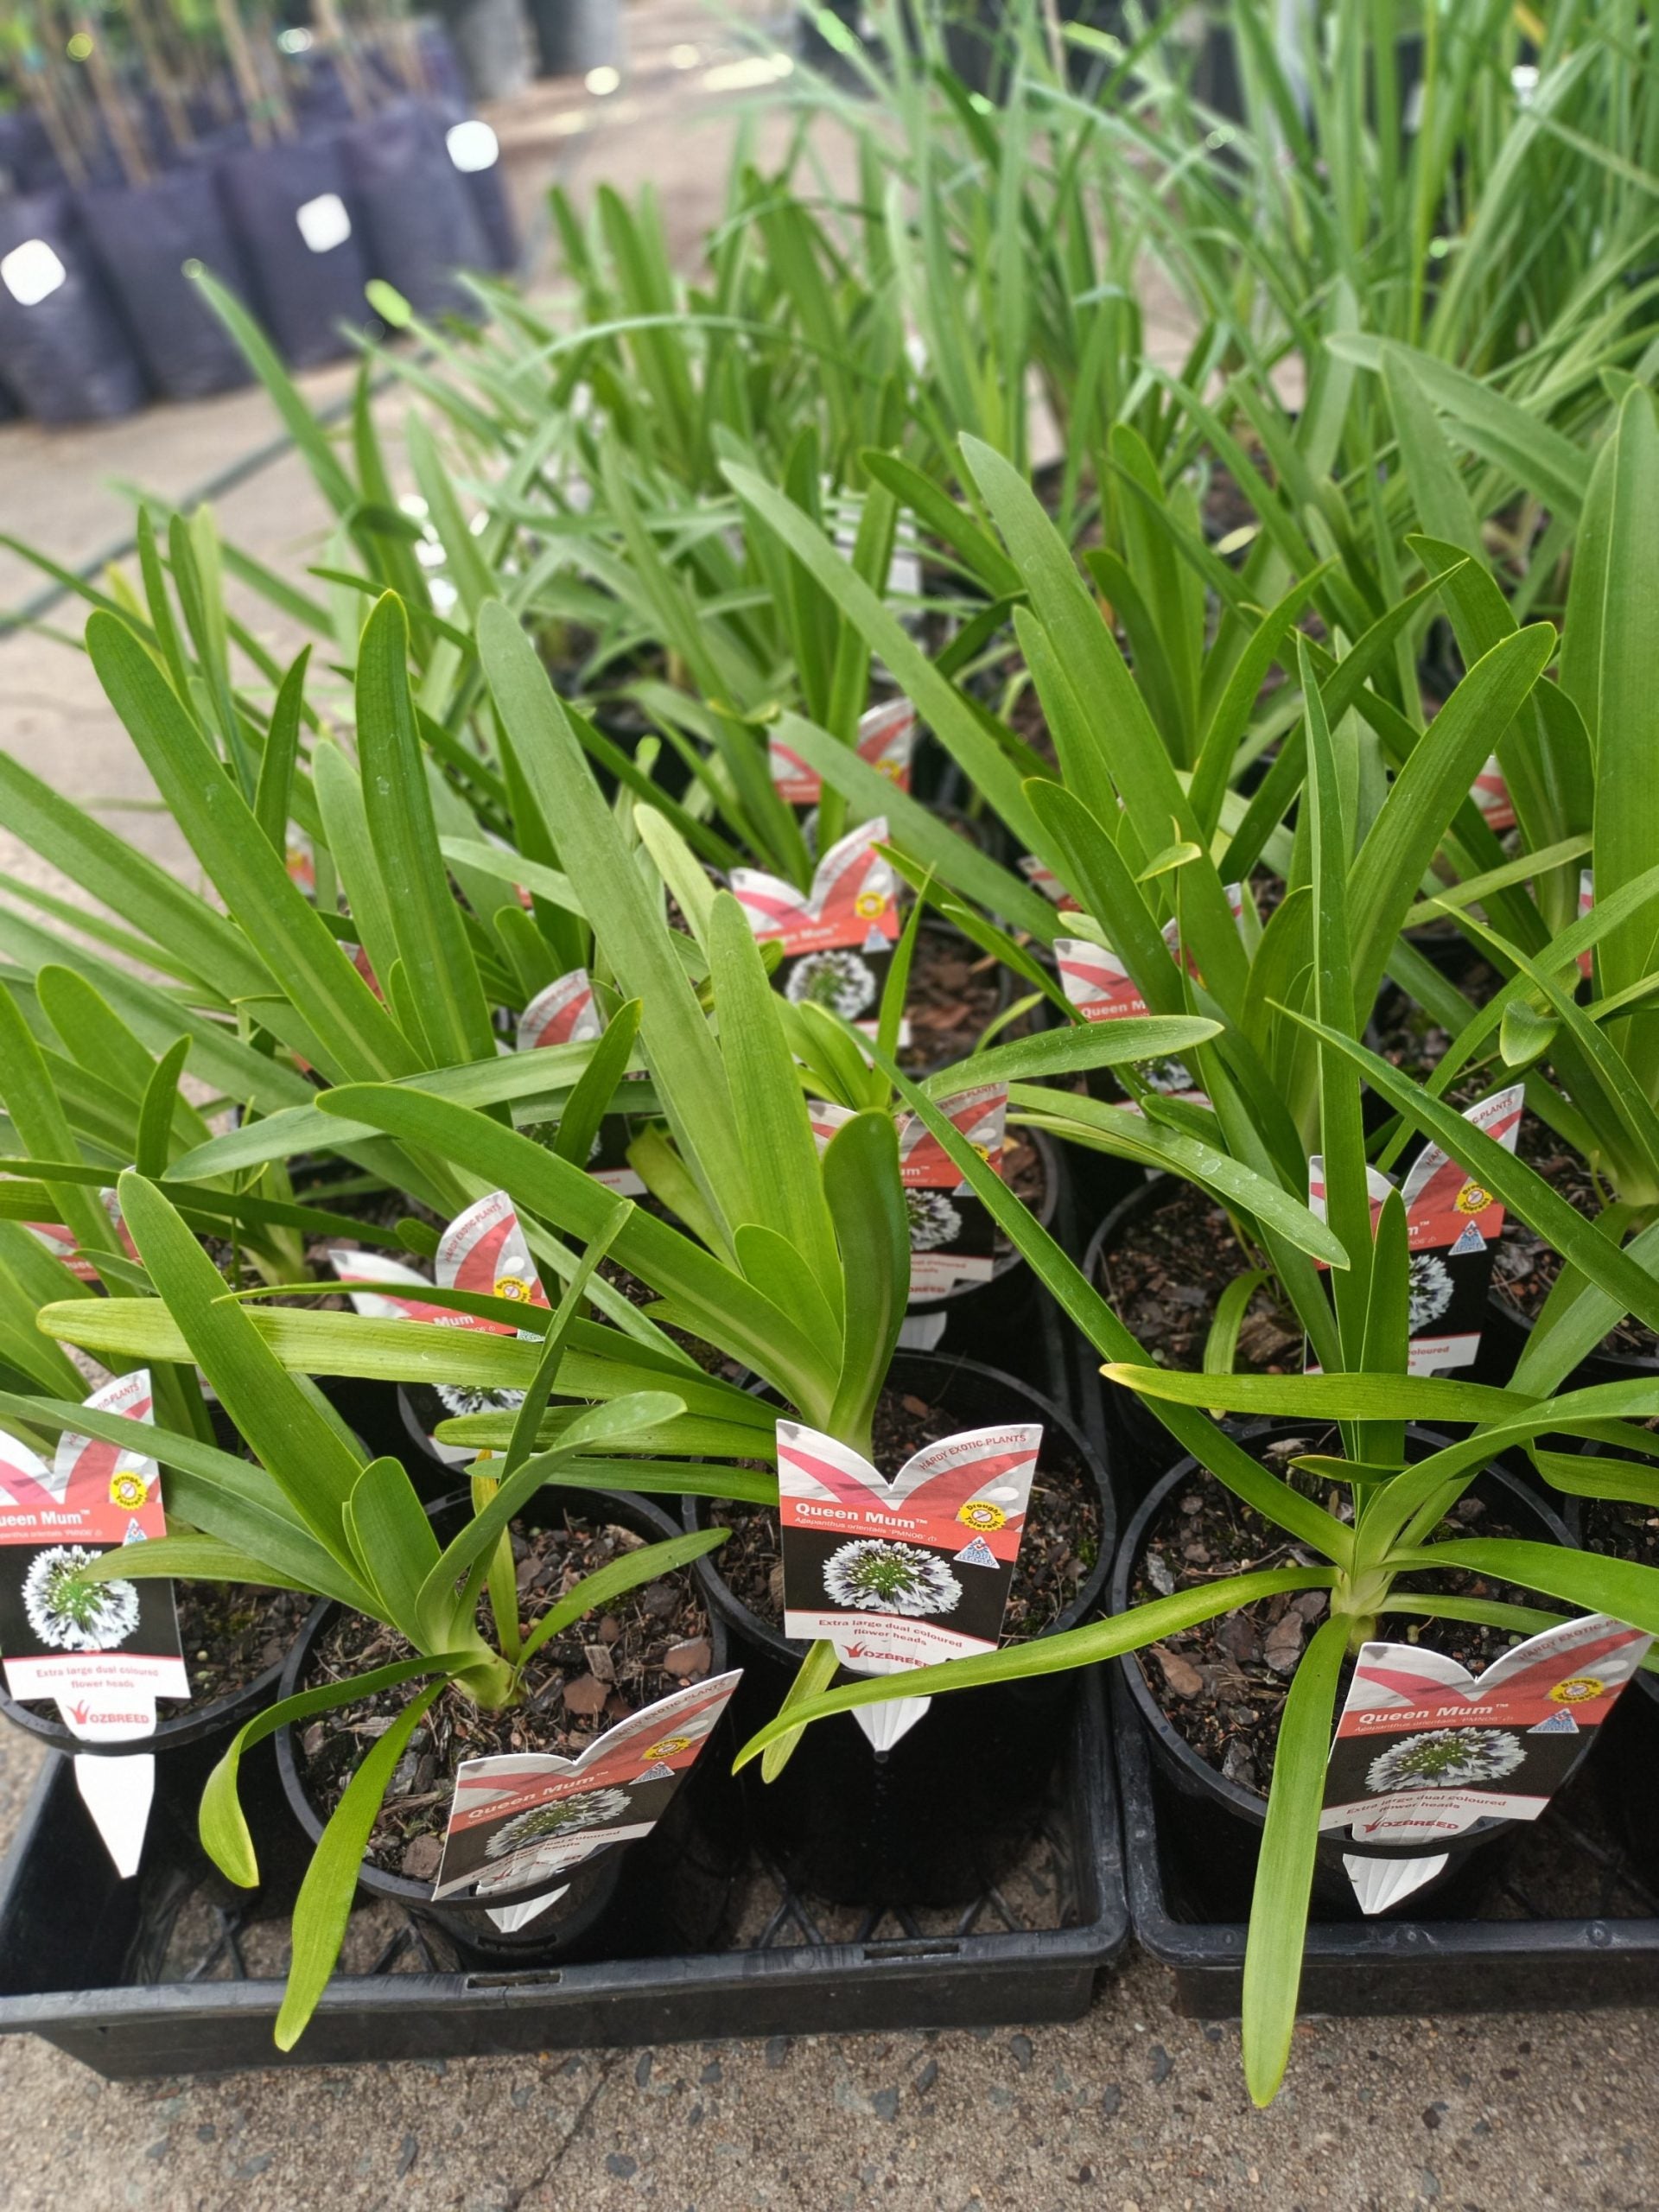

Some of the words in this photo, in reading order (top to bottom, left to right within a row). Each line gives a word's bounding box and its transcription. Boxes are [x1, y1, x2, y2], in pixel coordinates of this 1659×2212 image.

[1082, 1004, 1128, 1019] Queen
[1479, 1097, 1513, 1121] PLANTS
[475, 1202, 502, 1223] PLANTS
[110, 1382, 140, 1402] PLANTS
[919, 1451, 948, 1470] HARDY
[949, 1440, 983, 1455] EXOTIC
[986, 1434, 1027, 1446] PLANTS
[113, 1475, 142, 1487] Drought
[116, 1495, 143, 1507] Tolerant
[795, 1503, 859, 1521] Queen
[966, 1503, 1001, 1516] Drought
[0, 1516, 37, 1527] ueen
[794, 1516, 846, 1529] Agapanthus
[848, 1523, 887, 1535] orientalis
[965, 1516, 1001, 1529] Tolerant
[854, 1629, 890, 1637] flower
[893, 1632, 927, 1646] heads
[885, 1623, 910, 1632] dual
[913, 1629, 963, 1648] coloured
[1558, 1623, 1603, 1642] EXOTIC
[36, 1669, 64, 1678] Extra
[67, 1667, 92, 1675] large
[96, 1665, 117, 1674] dual
[119, 1667, 158, 1677] coloured
[71, 1680, 103, 1689] flower
[106, 1680, 134, 1688] heads
[683, 1681, 726, 1702] PLANTS
[90, 1713, 149, 1724] OZBREED
[1358, 1710, 1428, 1725] Queen
[467, 1793, 536, 1820] Queen
[1346, 1803, 1378, 1815] Extra
[1381, 1796, 1414, 1806] large
[1447, 1796, 1508, 1807] coloured
[1379, 1802, 1418, 1813] flower
[1382, 1820, 1459, 1830] OZBREED
